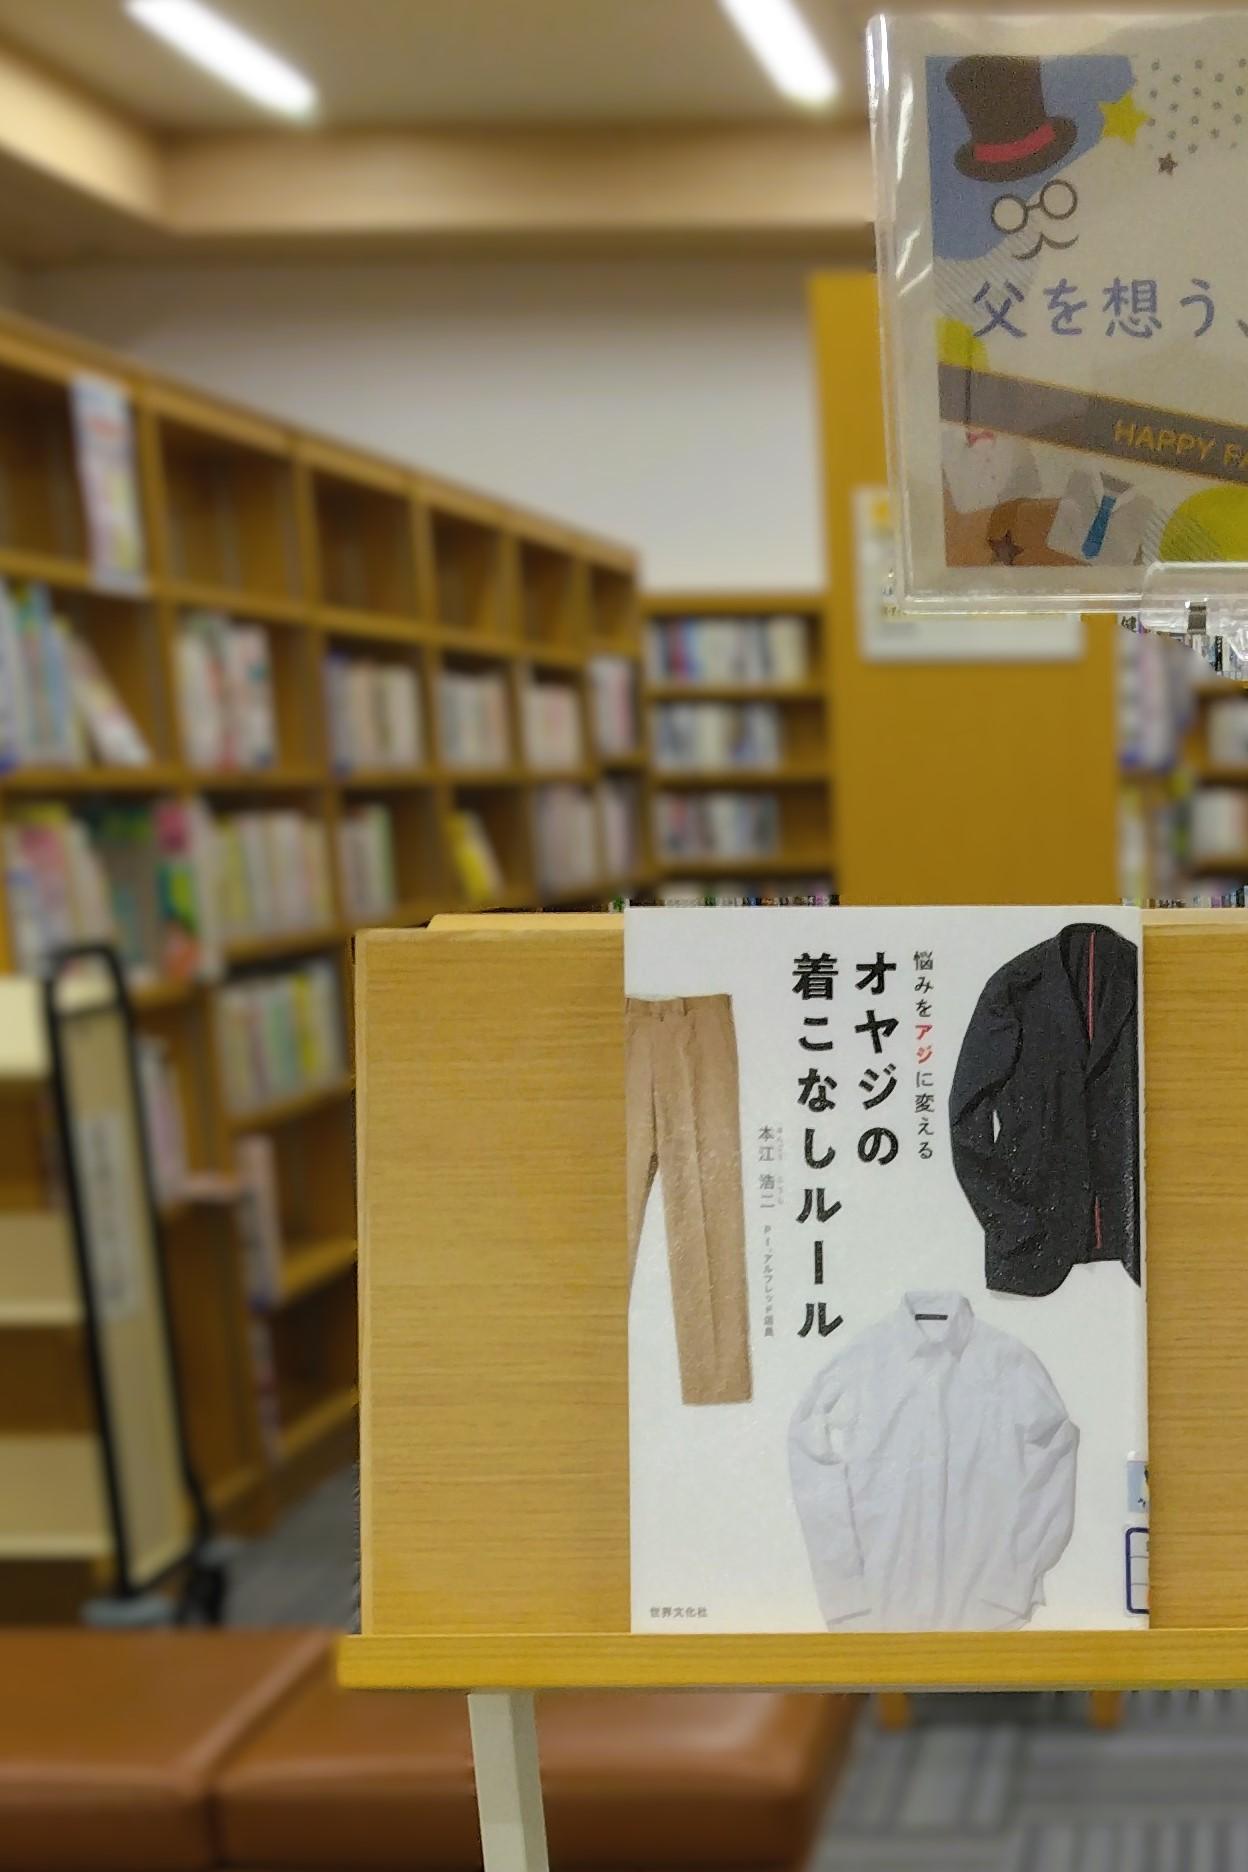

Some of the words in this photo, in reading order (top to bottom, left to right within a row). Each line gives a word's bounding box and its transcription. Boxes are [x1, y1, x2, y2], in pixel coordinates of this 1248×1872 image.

[1114, 419, 1216, 470] HAPPY
[791, 952, 843, 1338] 着こなしルール
[855, 952, 899, 1165] オヤジの
[913, 950, 936, 1160] 悩みをアジに変える
[650, 1606, 708, 1618] 世界文化社
